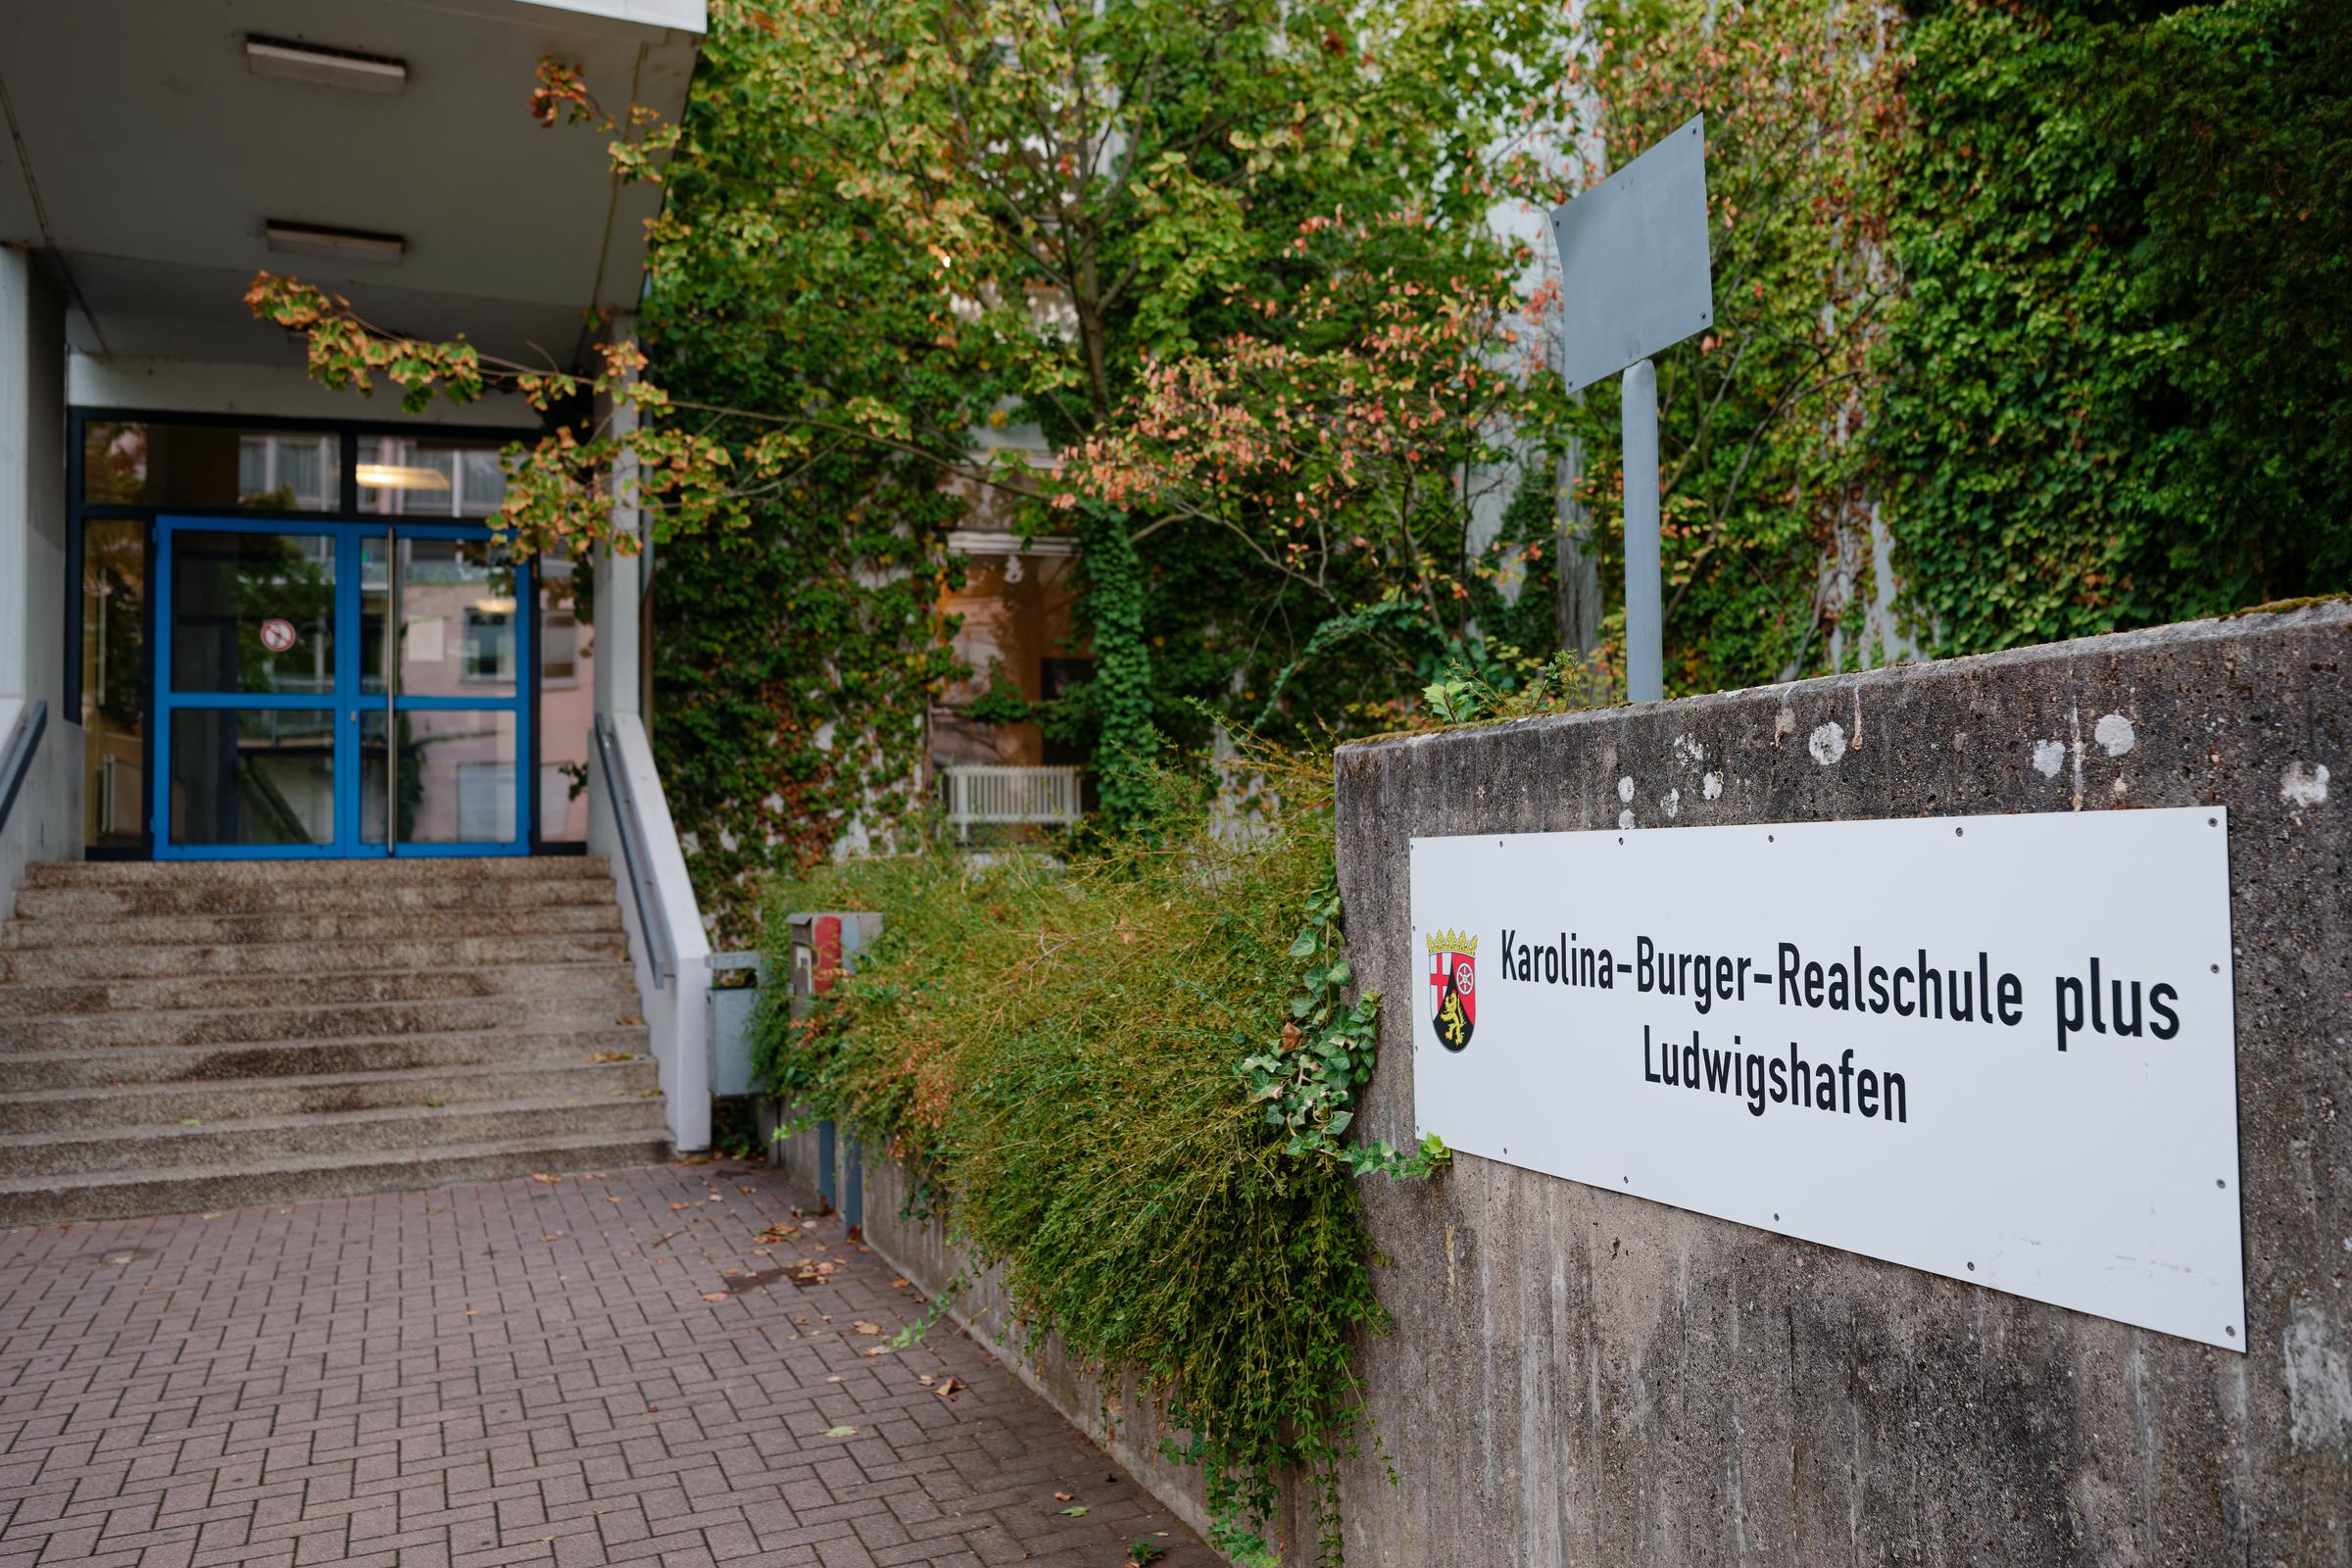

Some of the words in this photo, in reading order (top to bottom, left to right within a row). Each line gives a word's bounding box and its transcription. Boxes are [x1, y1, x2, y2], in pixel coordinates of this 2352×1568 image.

[1501, 929, 2024, 1027] Karolina-Burger-Realschule
[2055, 956, 2180, 1053] plus
[1643, 1024, 1907, 1124] Ludwigshafen
